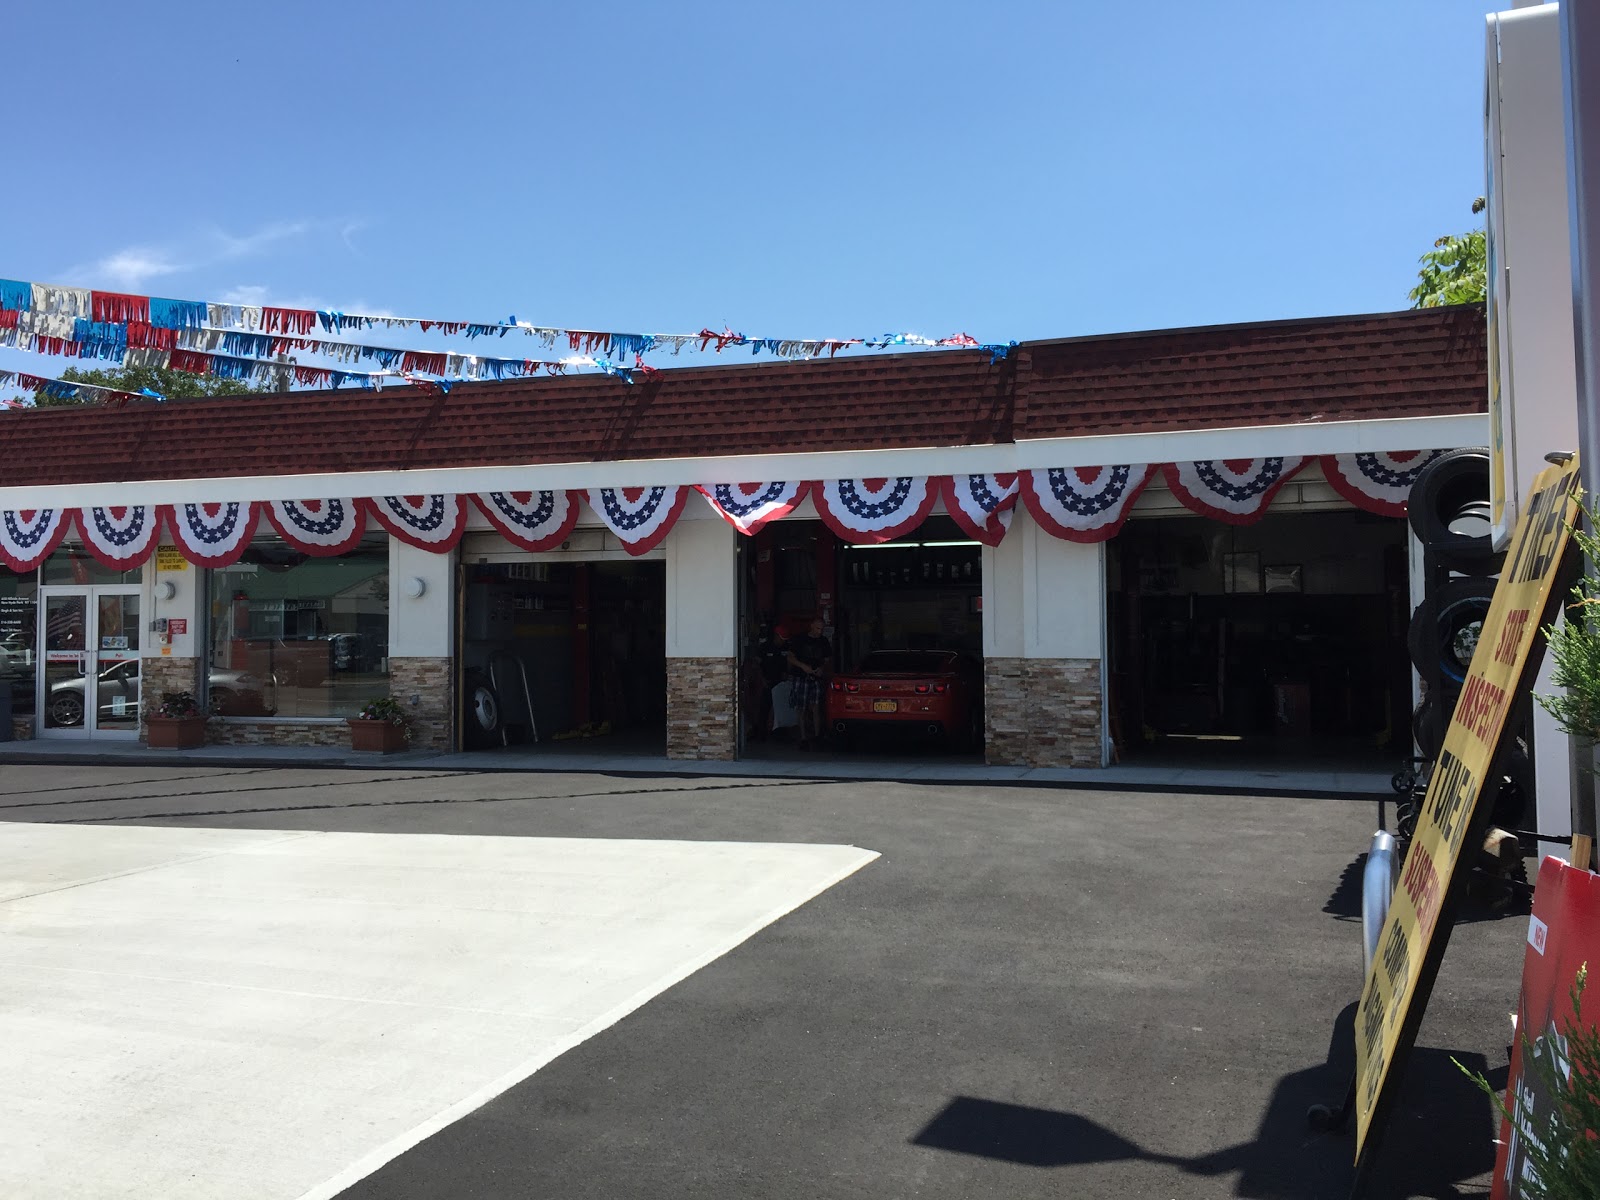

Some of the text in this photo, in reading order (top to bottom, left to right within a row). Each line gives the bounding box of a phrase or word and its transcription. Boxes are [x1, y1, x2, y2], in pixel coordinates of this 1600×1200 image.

[1508, 468, 1581, 584] TIRES
[1494, 609, 1530, 667] STATE
[1427, 750, 1471, 842] TUNE
